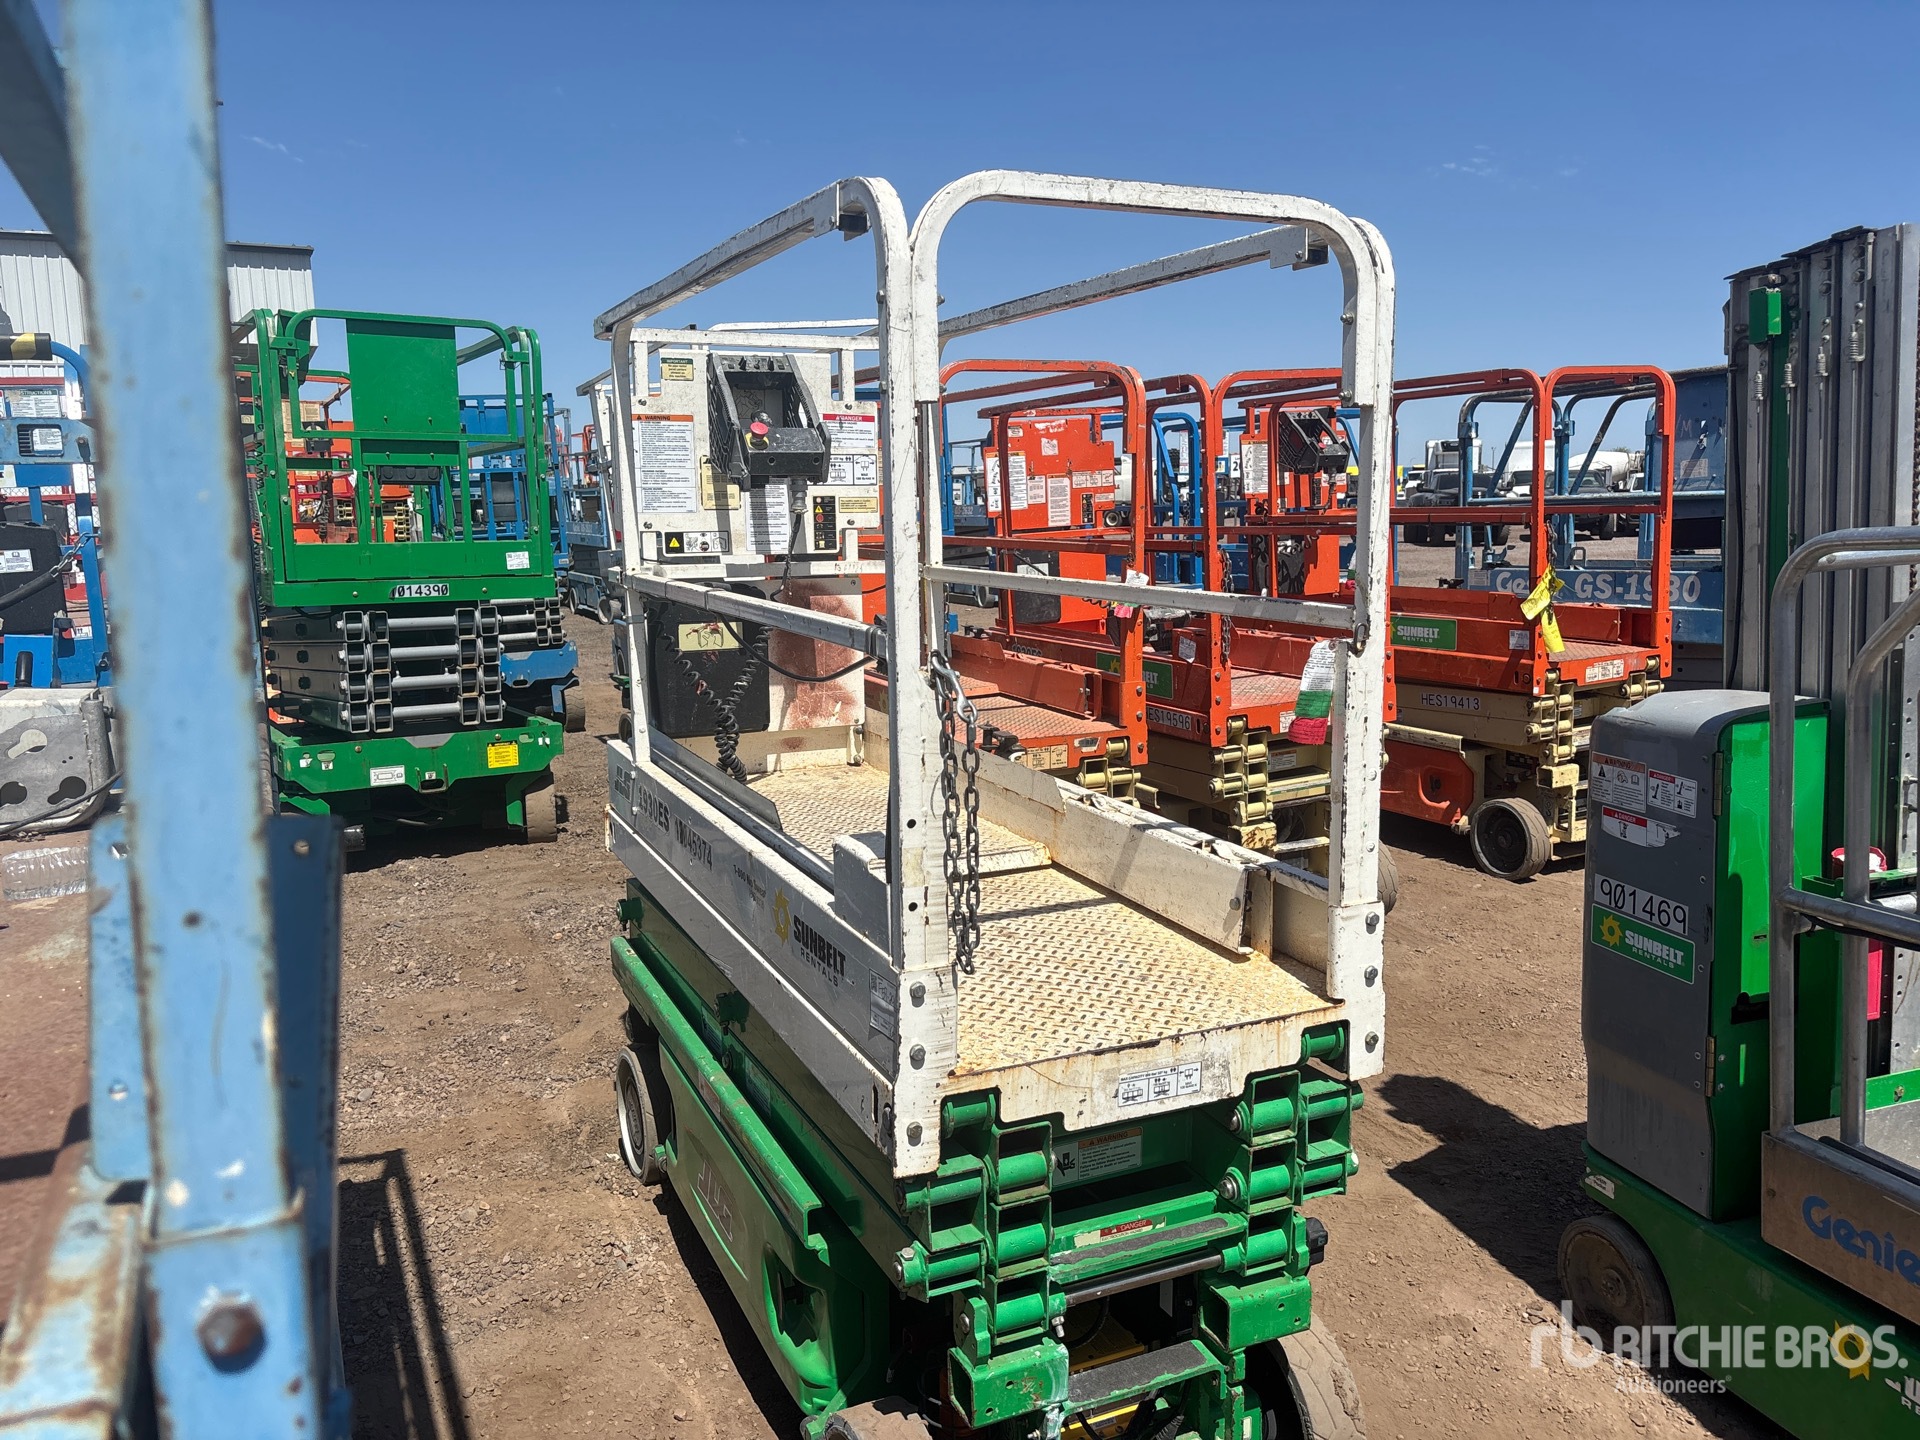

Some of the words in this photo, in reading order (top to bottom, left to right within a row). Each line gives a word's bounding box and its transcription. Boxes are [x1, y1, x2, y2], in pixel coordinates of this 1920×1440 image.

[397, 584, 448, 597] 014390
[1397, 626, 1440, 639] SUNBELT
[1421, 693, 1480, 711] HES19413
[1146, 707, 1191, 730] ES19596
[1618, 812, 1636, 823] DANGER
[1600, 879, 1687, 934] 901469
[793, 914, 846, 978] SUNBELT
[1625, 929, 1685, 966] SUNBELT
[1632, 946, 1675, 968] RENTALS
[800, 947, 839, 988] RENTALS
[1097, 1131, 1128, 1143] WARNING
[1120, 1220, 1147, 1231] DANGER
[1802, 1195, 1920, 1286] Genie
